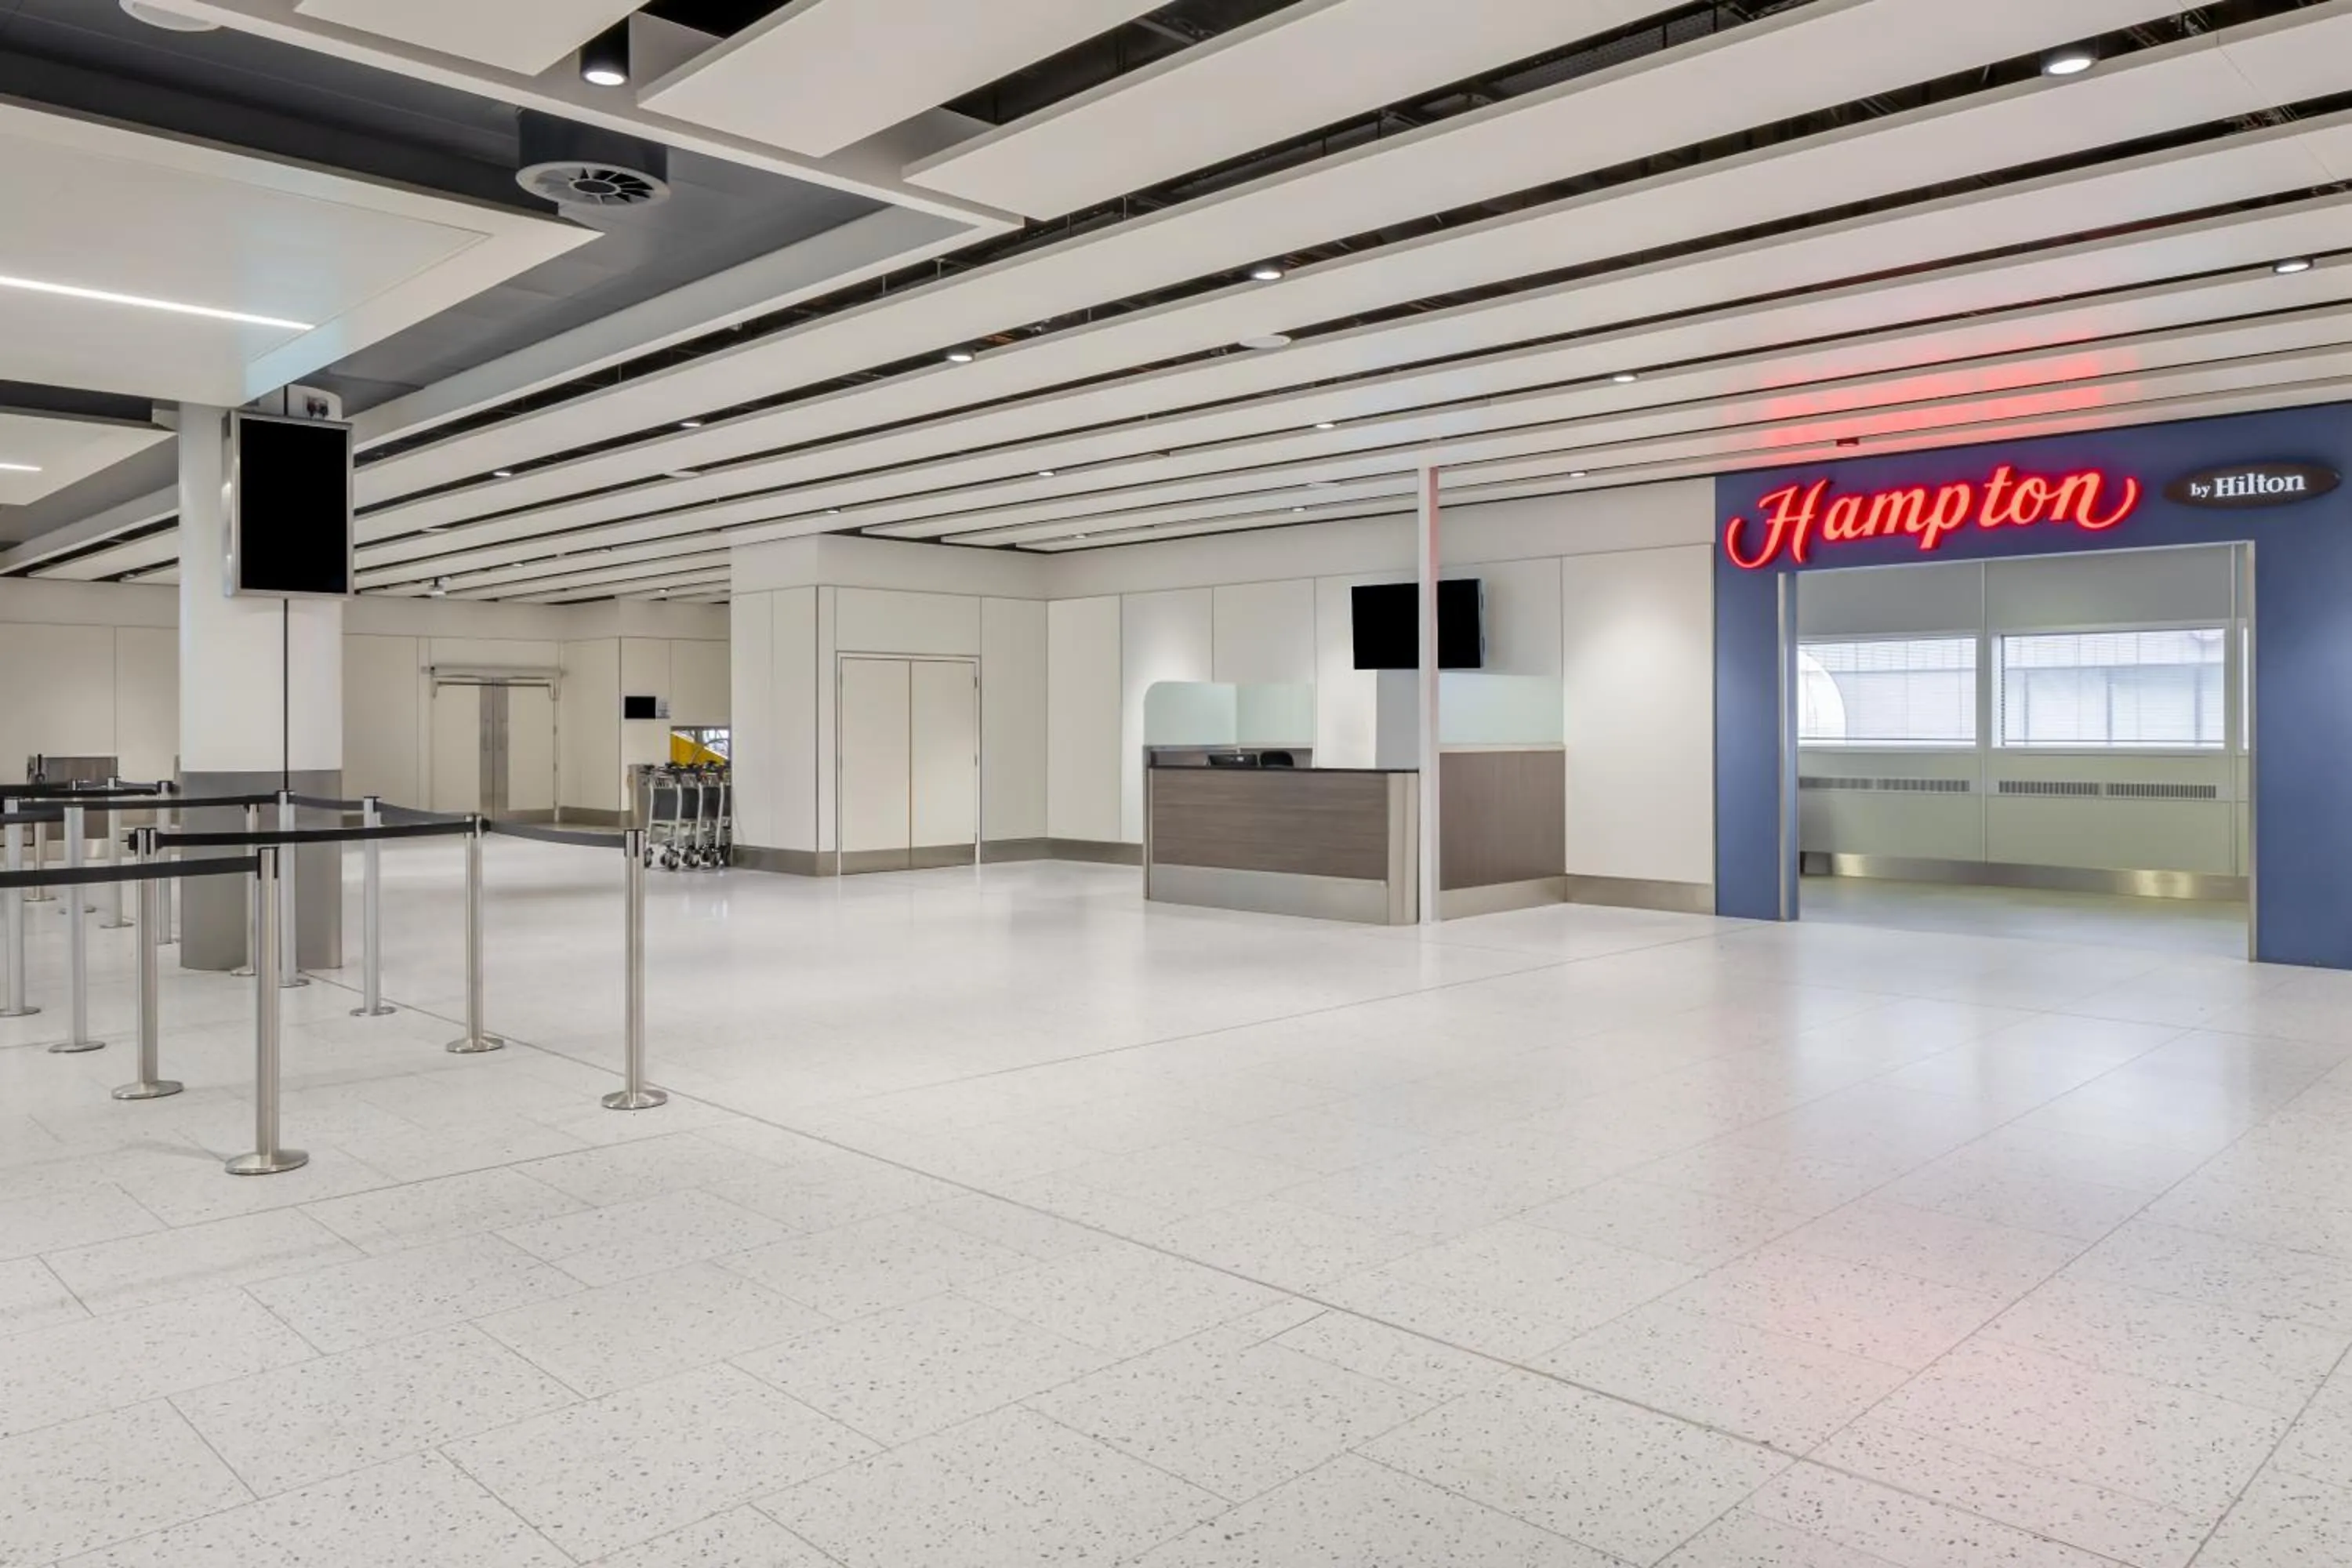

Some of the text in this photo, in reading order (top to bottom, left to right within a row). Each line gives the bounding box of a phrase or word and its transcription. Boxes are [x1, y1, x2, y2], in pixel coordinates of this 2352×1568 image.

[1725, 465, 2138, 569] Hampton
[2190, 473, 2307, 498] by Hilton
